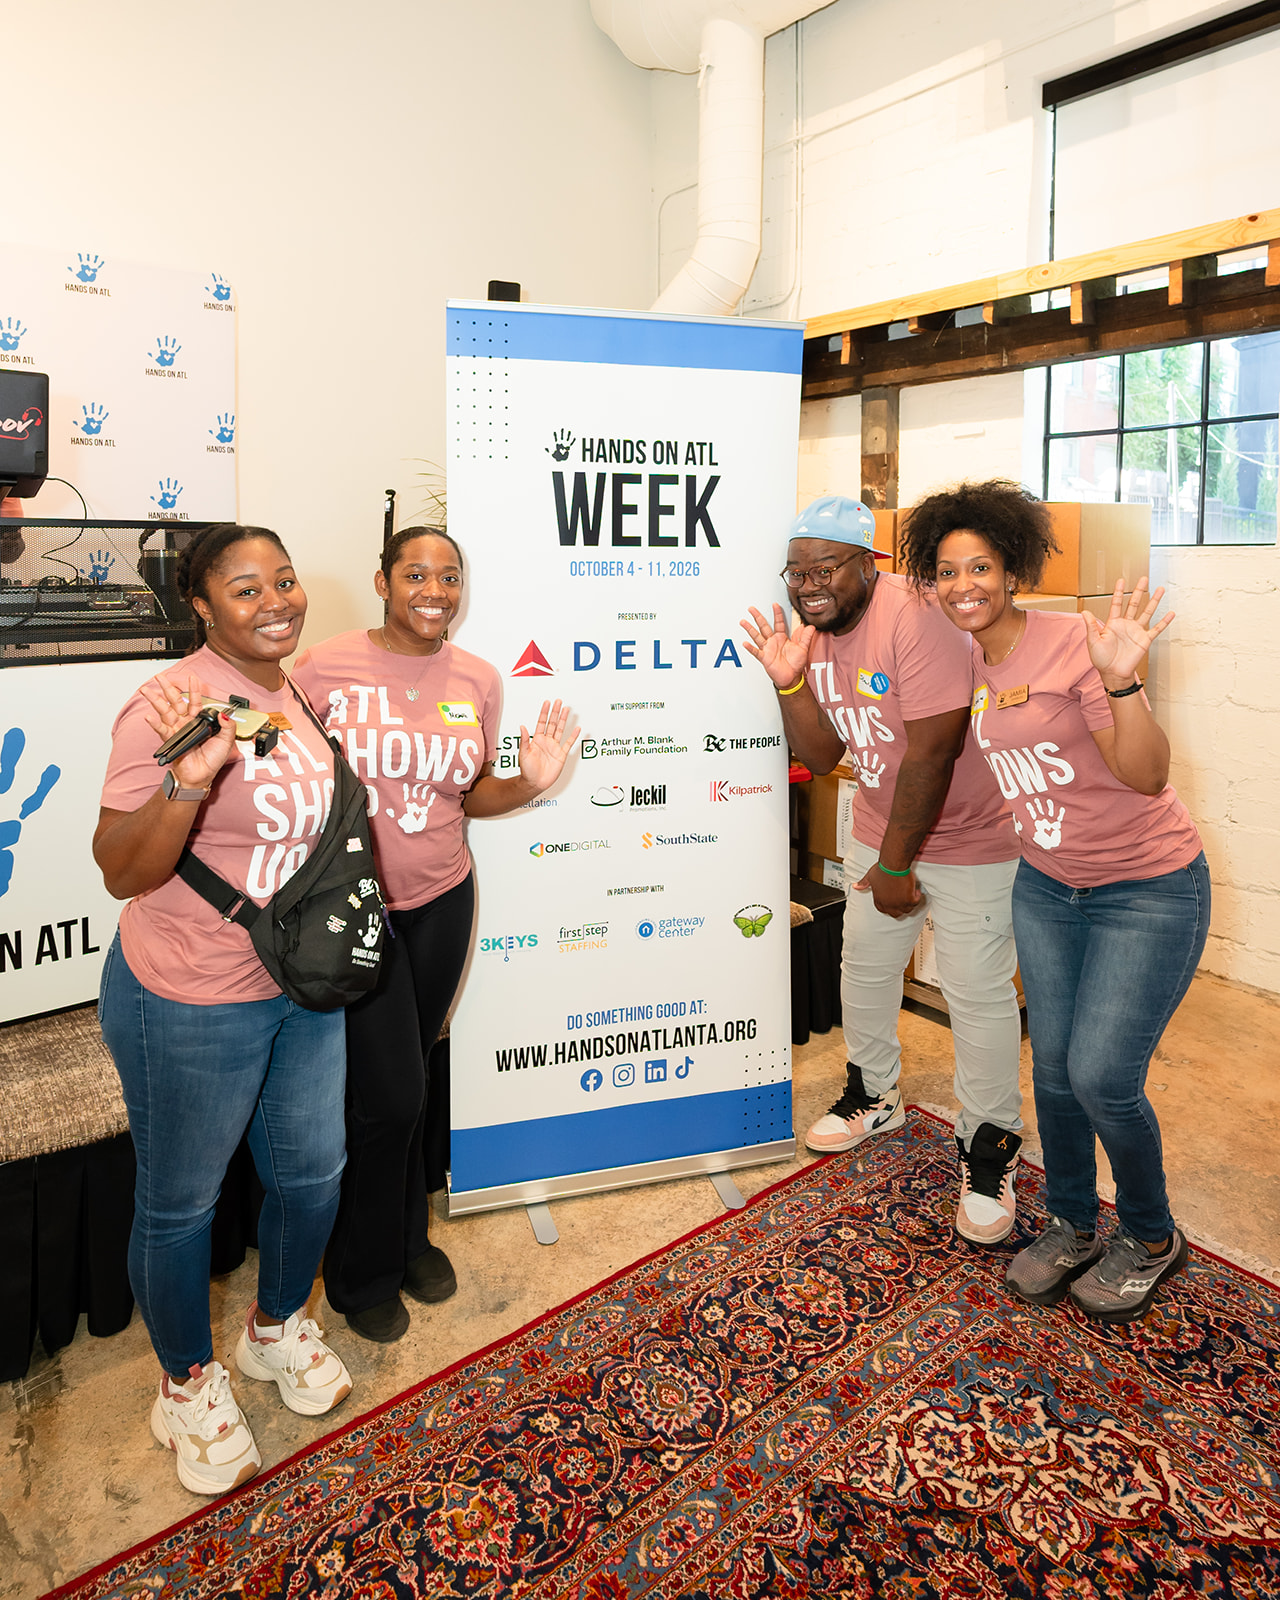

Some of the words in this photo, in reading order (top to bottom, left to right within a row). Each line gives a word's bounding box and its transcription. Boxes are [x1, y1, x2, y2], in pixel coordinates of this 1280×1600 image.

[65, 283, 87, 294] HANDS
[89, 286, 98, 295] ON
[100, 287, 111, 297] ATL
[203, 302, 223, 311] HANDS
[224, 304, 232, 312] ON
[11, 355, 21, 363] ON
[22, 356, 35, 365] ATL
[145, 368, 166, 378] HANDS
[167, 370, 176, 378] ON
[176, 370, 188, 379] ATL
[70, 437, 93, 446] HANDS
[94, 438, 103, 447] ON
[104, 438, 116, 447] ATL
[206, 445, 225, 453] HANDS
[226, 446, 234, 454] ON
[582, 437, 646, 464] HANDS
[653, 441, 678, 465] ON
[684, 442, 718, 466] ATL
[148, 511, 168, 520] HANDS
[169, 512, 178, 520] ON
[179, 512, 190, 520] ATL
[552, 471, 721, 547] WEEK
[570, 561, 623, 577] OCTOBER
[627, 561, 635, 577] 4
[647, 561, 665, 578] 11,
[669, 561, 700, 577] 2026
[617, 612, 649, 621] PRESENTED
[649, 612, 657, 620] BY
[573, 639, 743, 671] DELTA
[809, 661, 843, 704] TL
[325, 685, 404, 727] ATL
[610, 703, 624, 711] WITH
[625, 702, 649, 710] SUPPORT
[650, 701, 665, 710] FROM
[601, 738, 632, 747] Arthur
[633, 736, 645, 746] M.
[647, 735, 674, 746] Blank
[729, 738, 748, 750] THE
[749, 735, 781, 749] PEOPLE
[601, 747, 632, 757] Family
[633, 744, 688, 755] Foundation
[500, 755, 520, 769] BI
[630, 784, 667, 807] Jeckil
[729, 783, 773, 797] Kilpatrick
[545, 839, 612, 854] ONEDIGITAL
[655, 832, 719, 847] SouthState
[606, 888, 613, 897] IN
[613, 885, 649, 896] PARTNERSHIP
[650, 884, 665, 893] WITH
[658, 916, 705, 930] gateway
[559, 926, 582, 939] first
[585, 925, 608, 938] step
[658, 927, 695, 939] center
[35, 916, 100, 966] ATL
[480, 934, 538, 952] 3KEYS
[559, 939, 608, 954] STAFFING
[567, 1013, 583, 1030] DO
[586, 1005, 653, 1028] SOMETHING
[656, 1001, 687, 1019] GOOD
[689, 999, 708, 1015] AT:
[495, 1018, 758, 1073] WWW.HANDSONATLANTA.ORG
